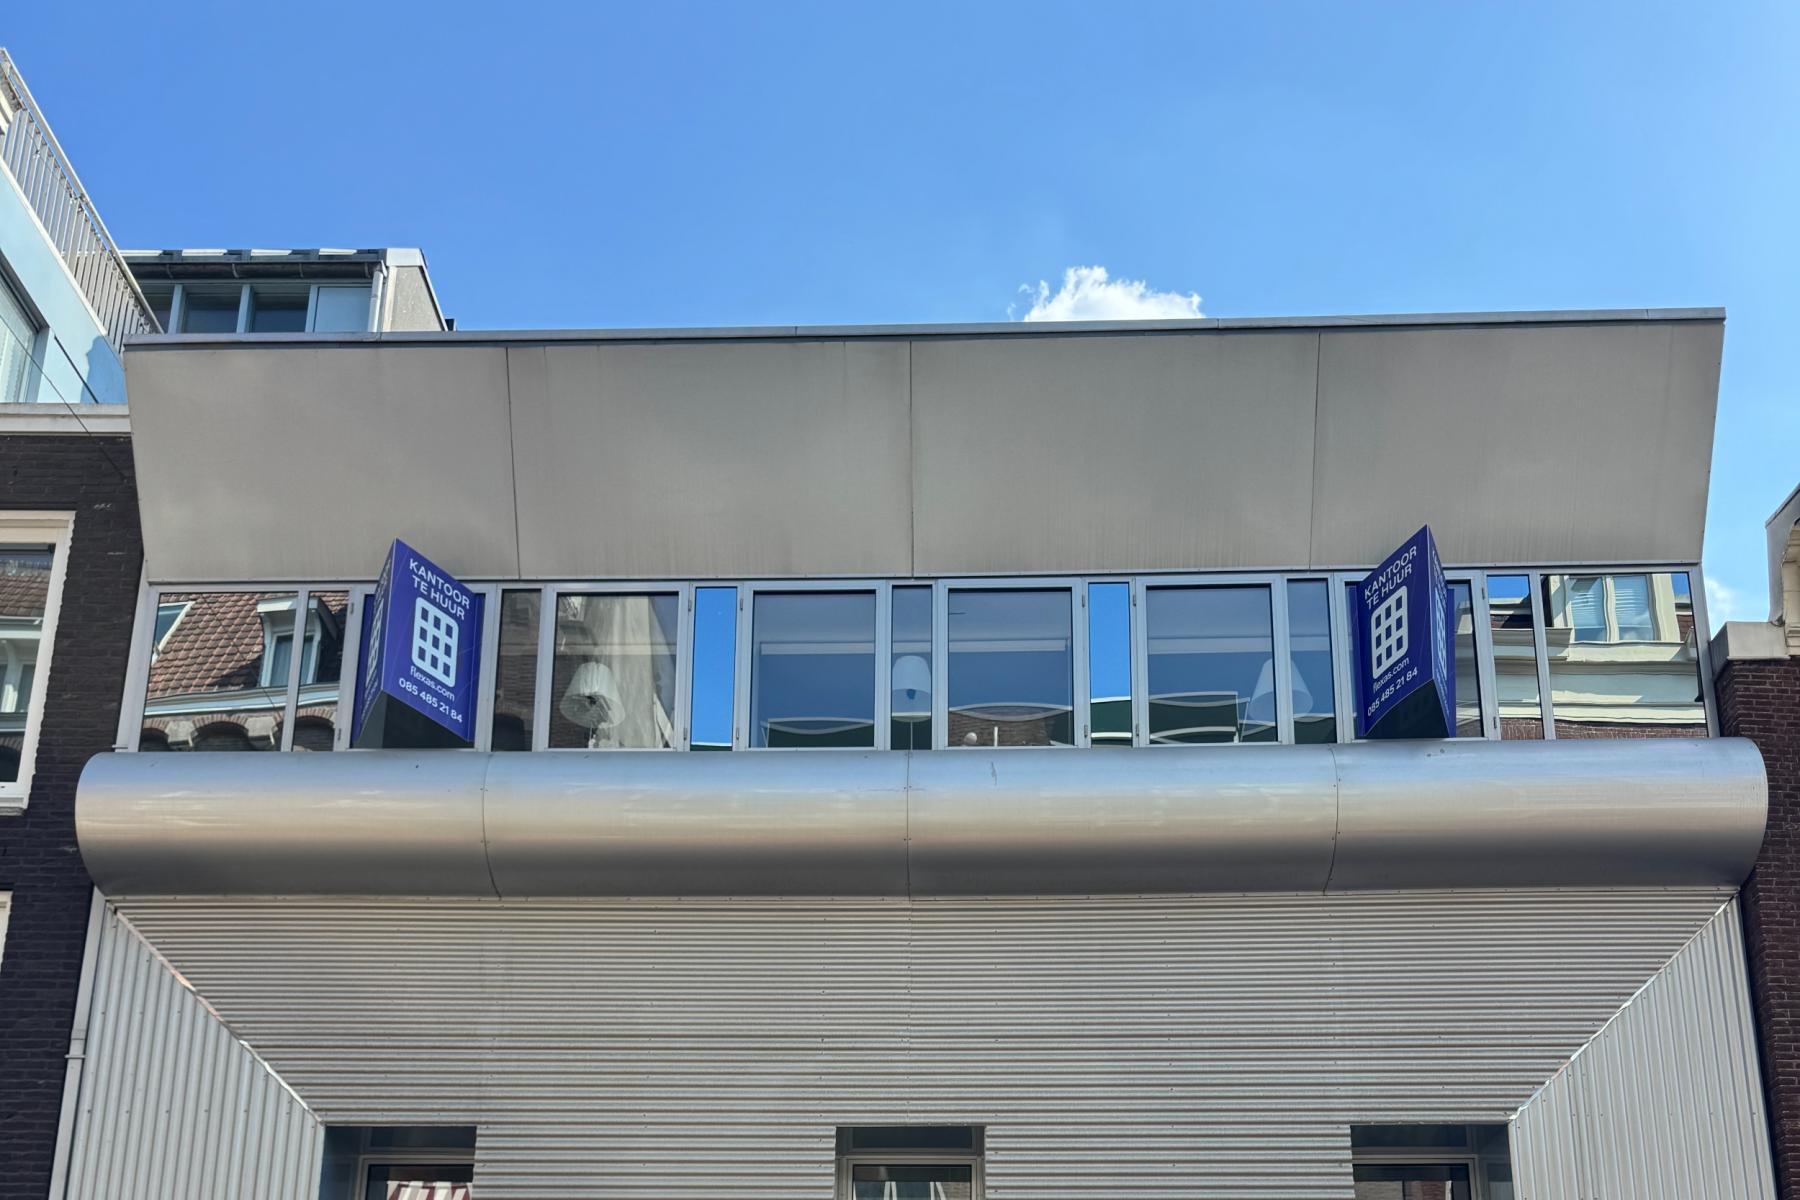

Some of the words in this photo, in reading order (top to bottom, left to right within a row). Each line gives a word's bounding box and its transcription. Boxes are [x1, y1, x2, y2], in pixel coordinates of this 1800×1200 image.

[409, 558, 470, 609] KANTOOR
[1364, 545, 1417, 600] KANTOOR
[1366, 592, 1379, 610] TE
[1381, 563, 1413, 597] HUUR
[412, 575, 428, 595] TE
[430, 586, 465, 620] HUUR
[398, 677, 418, 696] 085
[419, 688, 438, 708] 485
[439, 700, 449, 716] 21
[450, 707, 463, 723] 84
[410, 665, 455, 702] flexas.com
[1367, 699, 1380, 717] 085
[1380, 686, 1395, 704] 485
[1396, 677, 1405, 693] 21
[1406, 666, 1418, 682] 84
